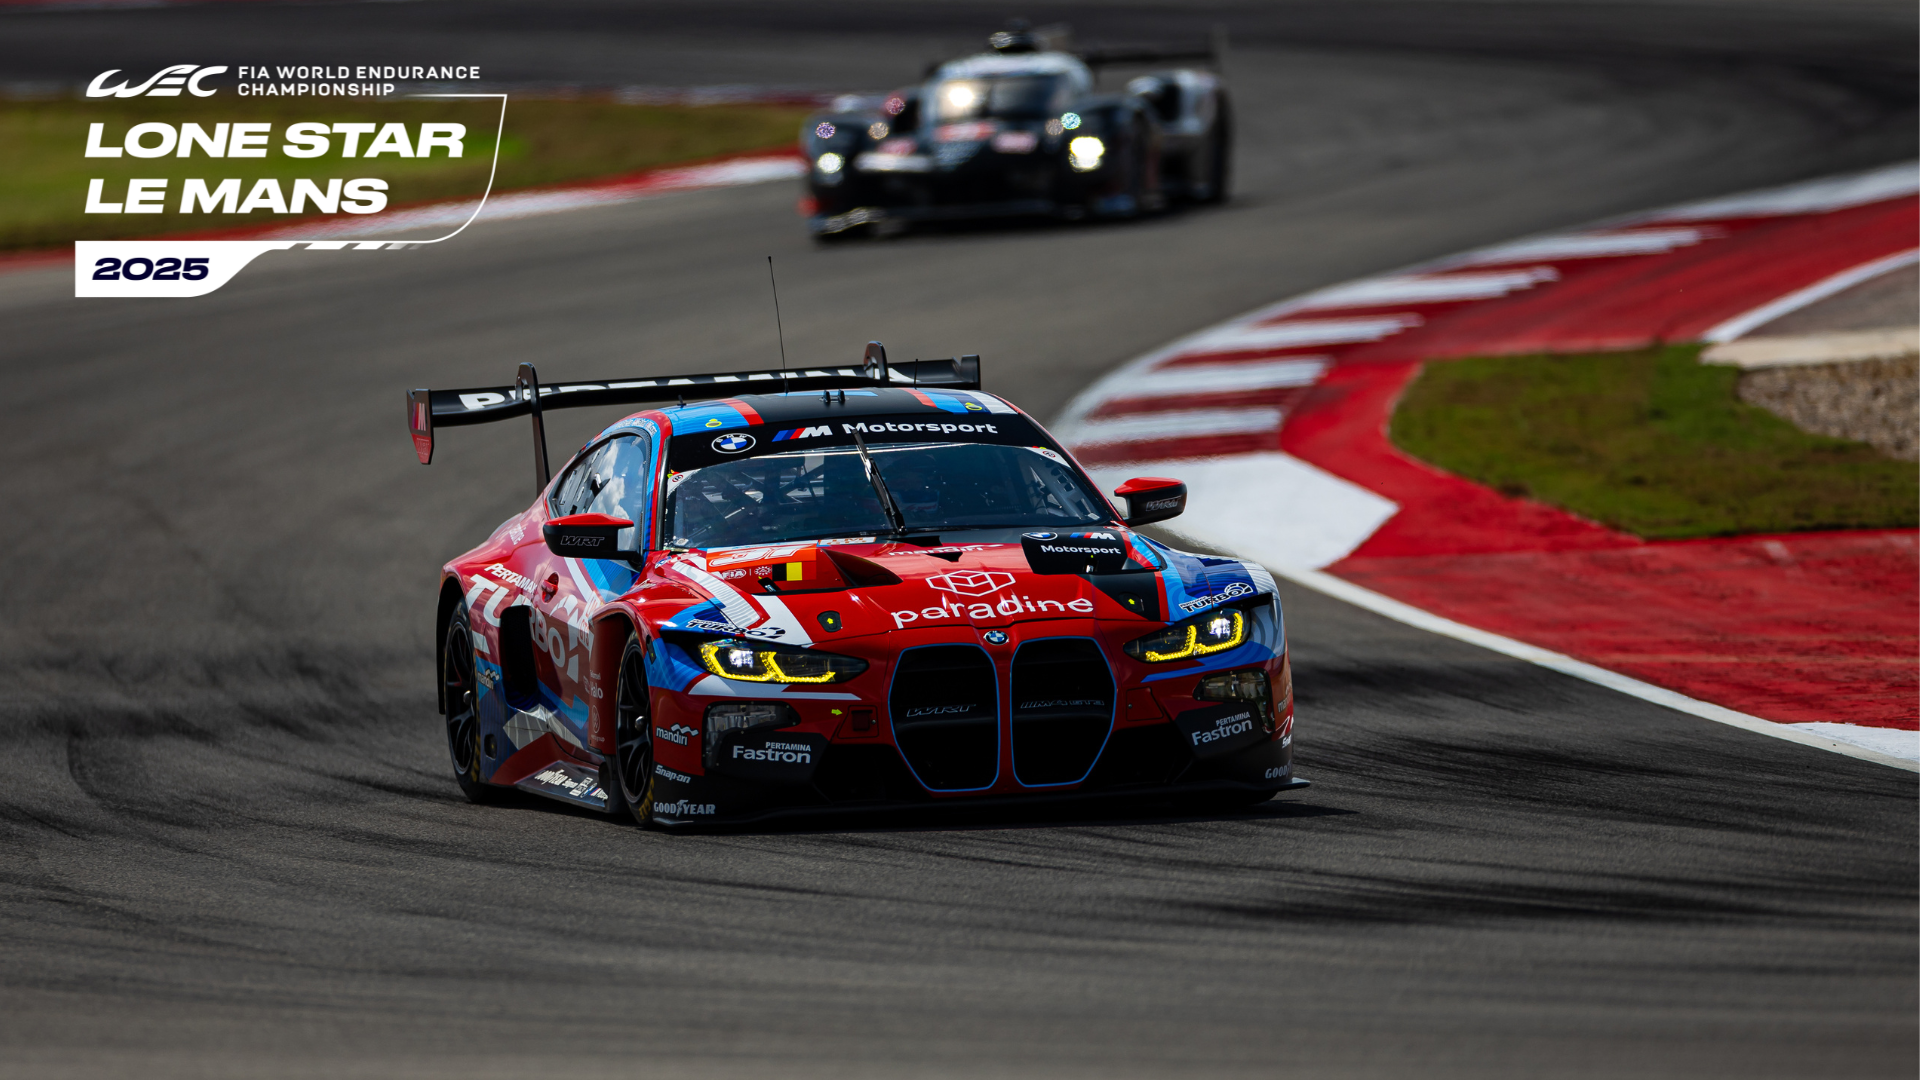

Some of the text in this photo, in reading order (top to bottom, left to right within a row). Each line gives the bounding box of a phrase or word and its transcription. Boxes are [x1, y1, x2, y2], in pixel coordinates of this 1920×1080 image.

[842, 421, 998, 435] Motorsport
[560, 535, 605, 547] WRT
[1041, 544, 1121, 556] Motorsport
[484, 562, 538, 598] PERTAMAX
[890, 594, 1095, 628] paradine
[1215, 711, 1251, 727] PERTAMINA
[656, 726, 688, 746] mandiri
[1191, 719, 1253, 746] Fastron
[732, 744, 811, 764] Fastron
[765, 741, 811, 752] PERTAMINA
[655, 764, 691, 784] Snap-on
[653, 799, 716, 818] GOODYEAR
